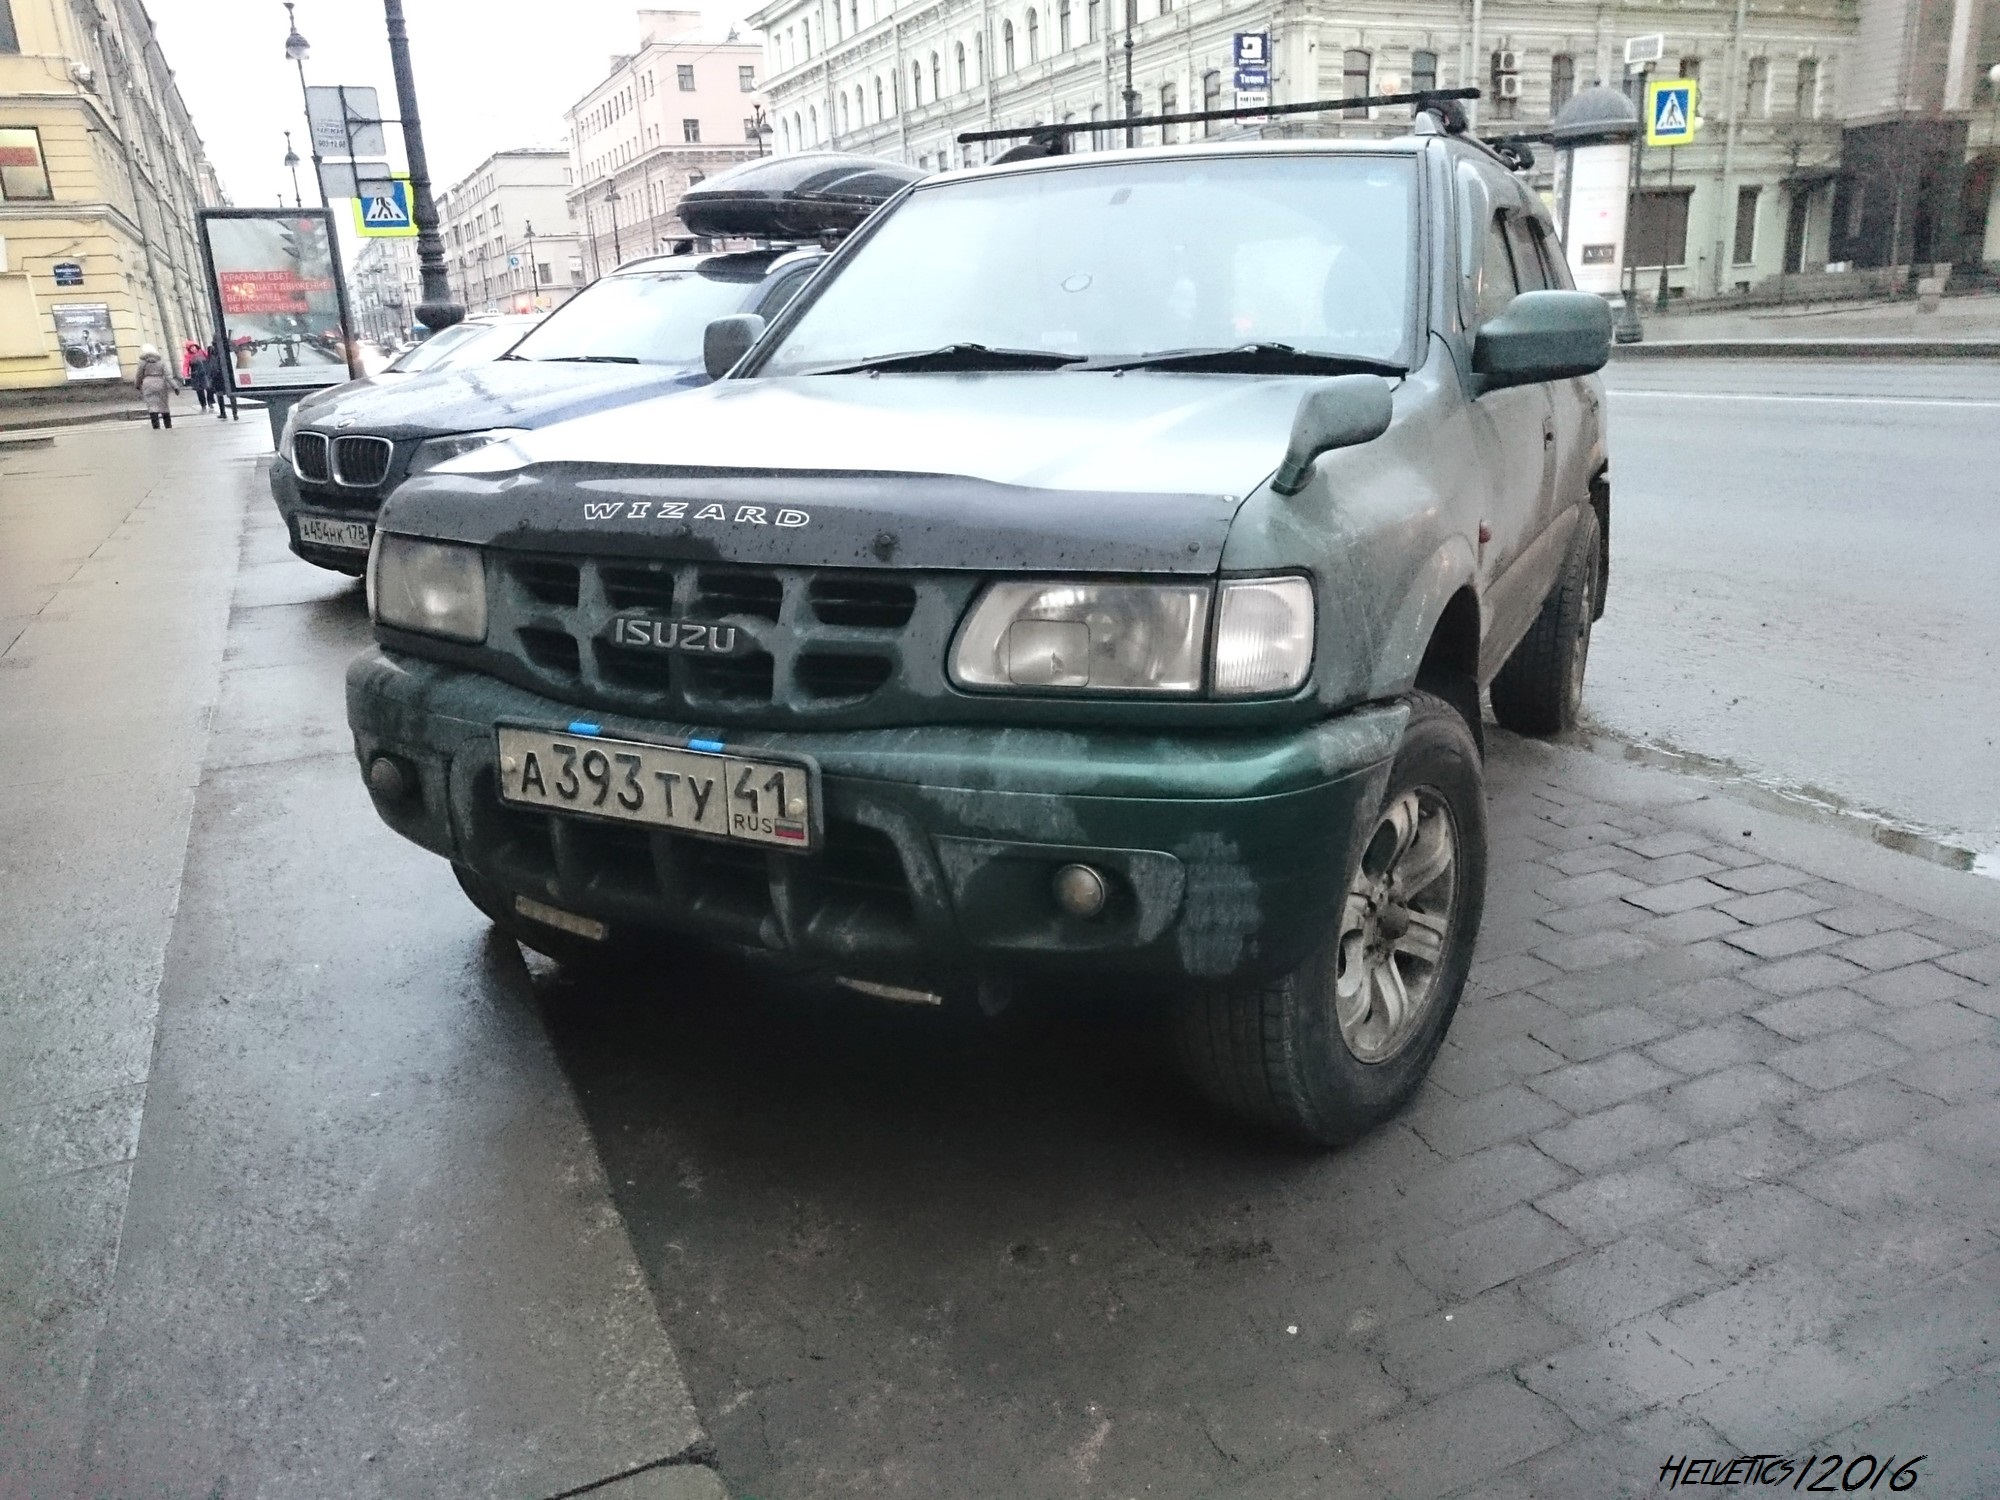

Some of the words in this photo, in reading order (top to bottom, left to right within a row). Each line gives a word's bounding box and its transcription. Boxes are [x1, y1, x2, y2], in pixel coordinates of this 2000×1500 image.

[223, 272, 266, 281] КРАСНЫЙ
[268, 272, 289, 280] СВЕТ
[228, 304, 240, 312] НЕ
[584, 502, 810, 528] WIZARD
[615, 618, 736, 653] ISUZU
[734, 765, 787, 818] 41
[733, 813, 773, 834] RUS
